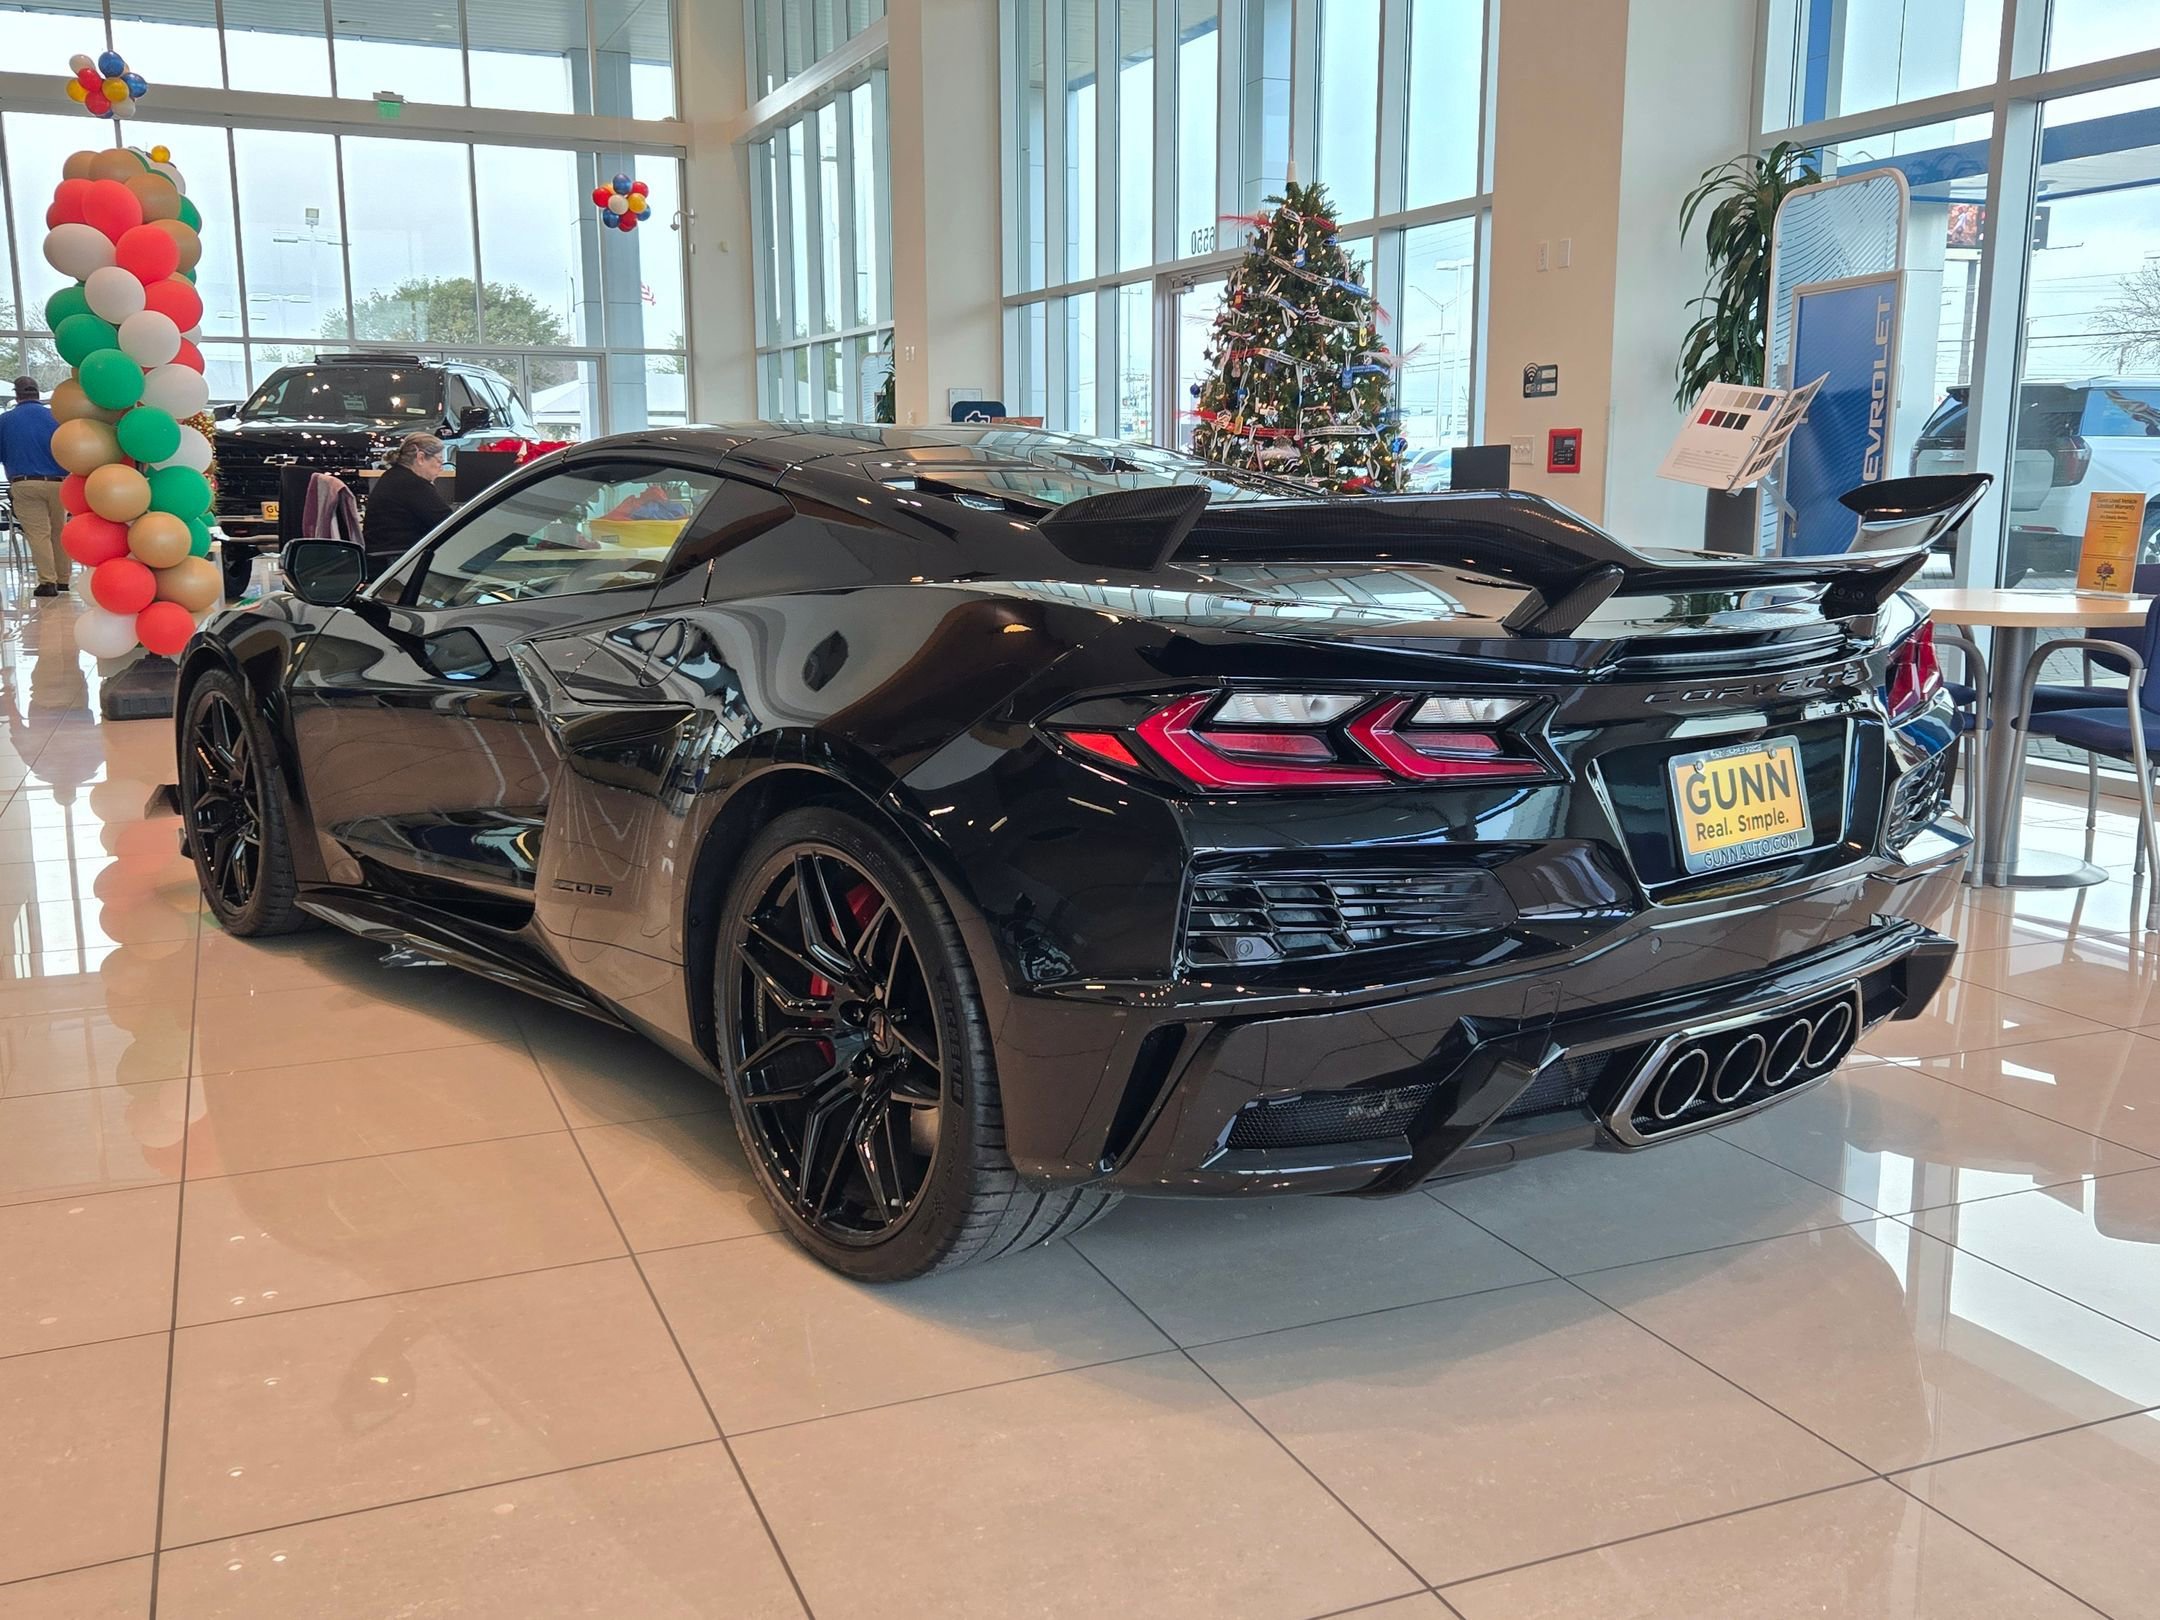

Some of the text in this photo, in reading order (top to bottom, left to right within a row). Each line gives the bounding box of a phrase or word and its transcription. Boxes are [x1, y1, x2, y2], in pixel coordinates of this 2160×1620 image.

[1643, 668, 1860, 704] CORVETTE
[1686, 760, 1791, 815] GUNN
[1696, 817, 1733, 841] Real.
[1704, 833, 1799, 868] GUNNAUTO.COM
